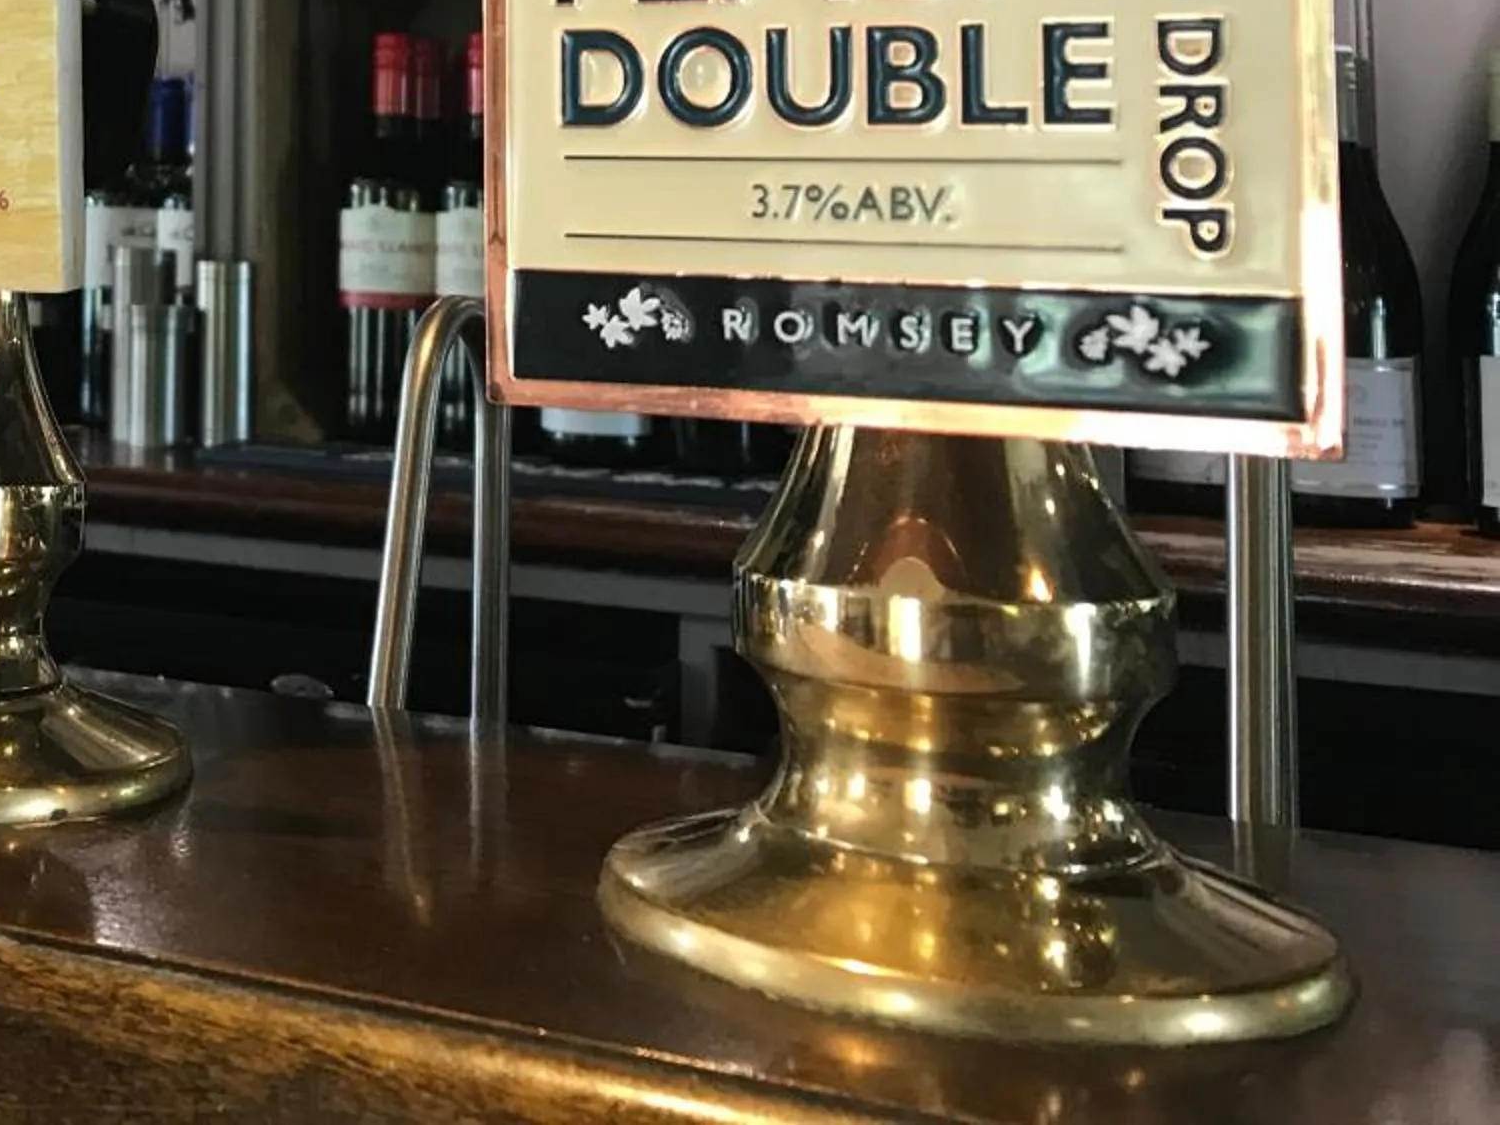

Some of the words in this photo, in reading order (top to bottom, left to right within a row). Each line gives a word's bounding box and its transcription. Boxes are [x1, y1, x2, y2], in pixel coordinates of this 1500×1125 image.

[560, 22, 1113, 128] DOUBLE
[1157, 18, 1229, 257] DROP
[722, 309, 1036, 354] ROMSEY
